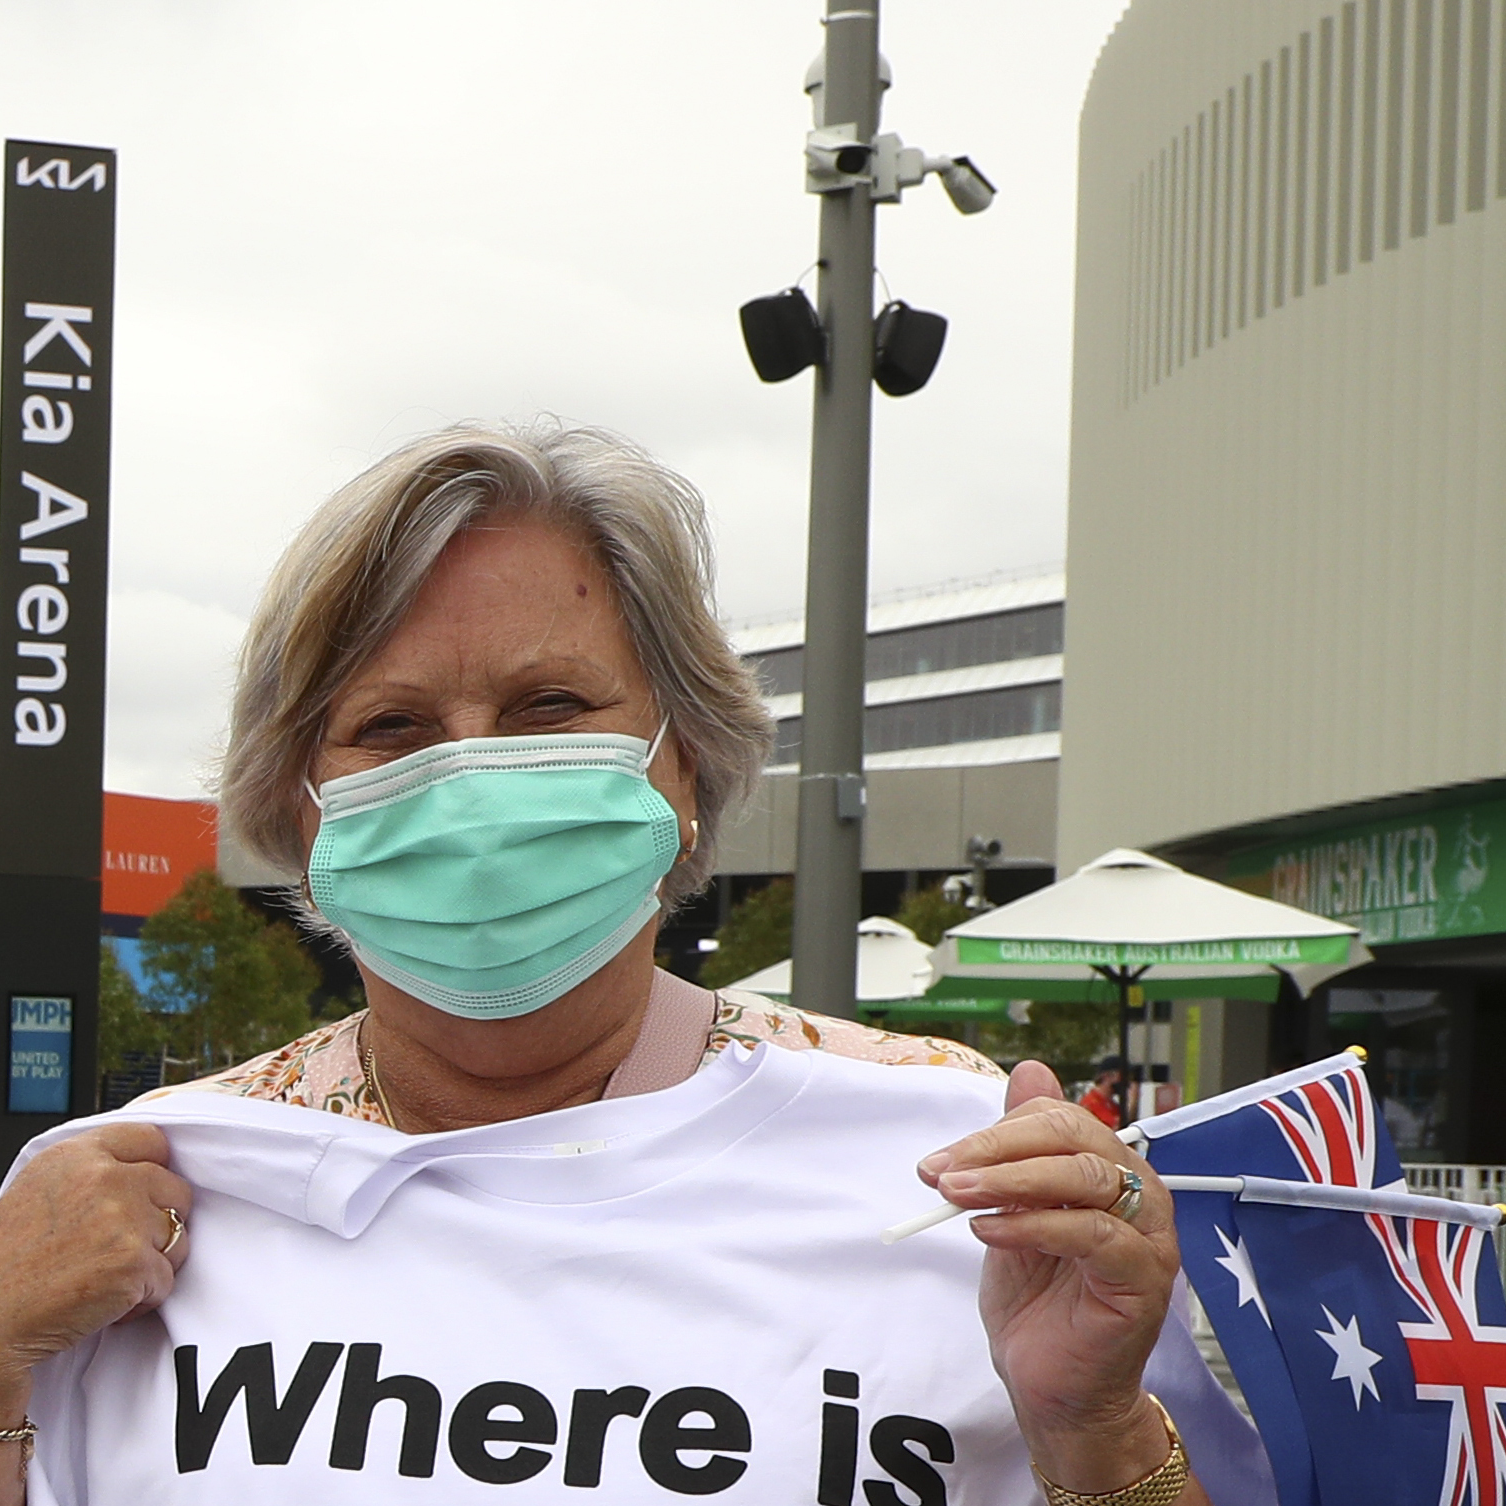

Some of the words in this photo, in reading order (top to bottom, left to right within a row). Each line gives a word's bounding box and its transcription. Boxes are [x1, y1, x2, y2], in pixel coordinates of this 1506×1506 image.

[22, 302, 93, 444] Kia
[15, 470, 88, 746] Arena
[105, 850, 171, 874] LAUREN
[1000, 941, 1117, 962] GRAINSHAKER
[1124, 942, 1234, 962] AUSTRALIAN
[1241, 940, 1301, 960] VODKA
[12, 1051, 59, 1066] UNITED
[12, 1065, 29, 1078] BY
[32, 1066, 64, 1079] PLAY
[173, 1341, 752, 1496] Where
